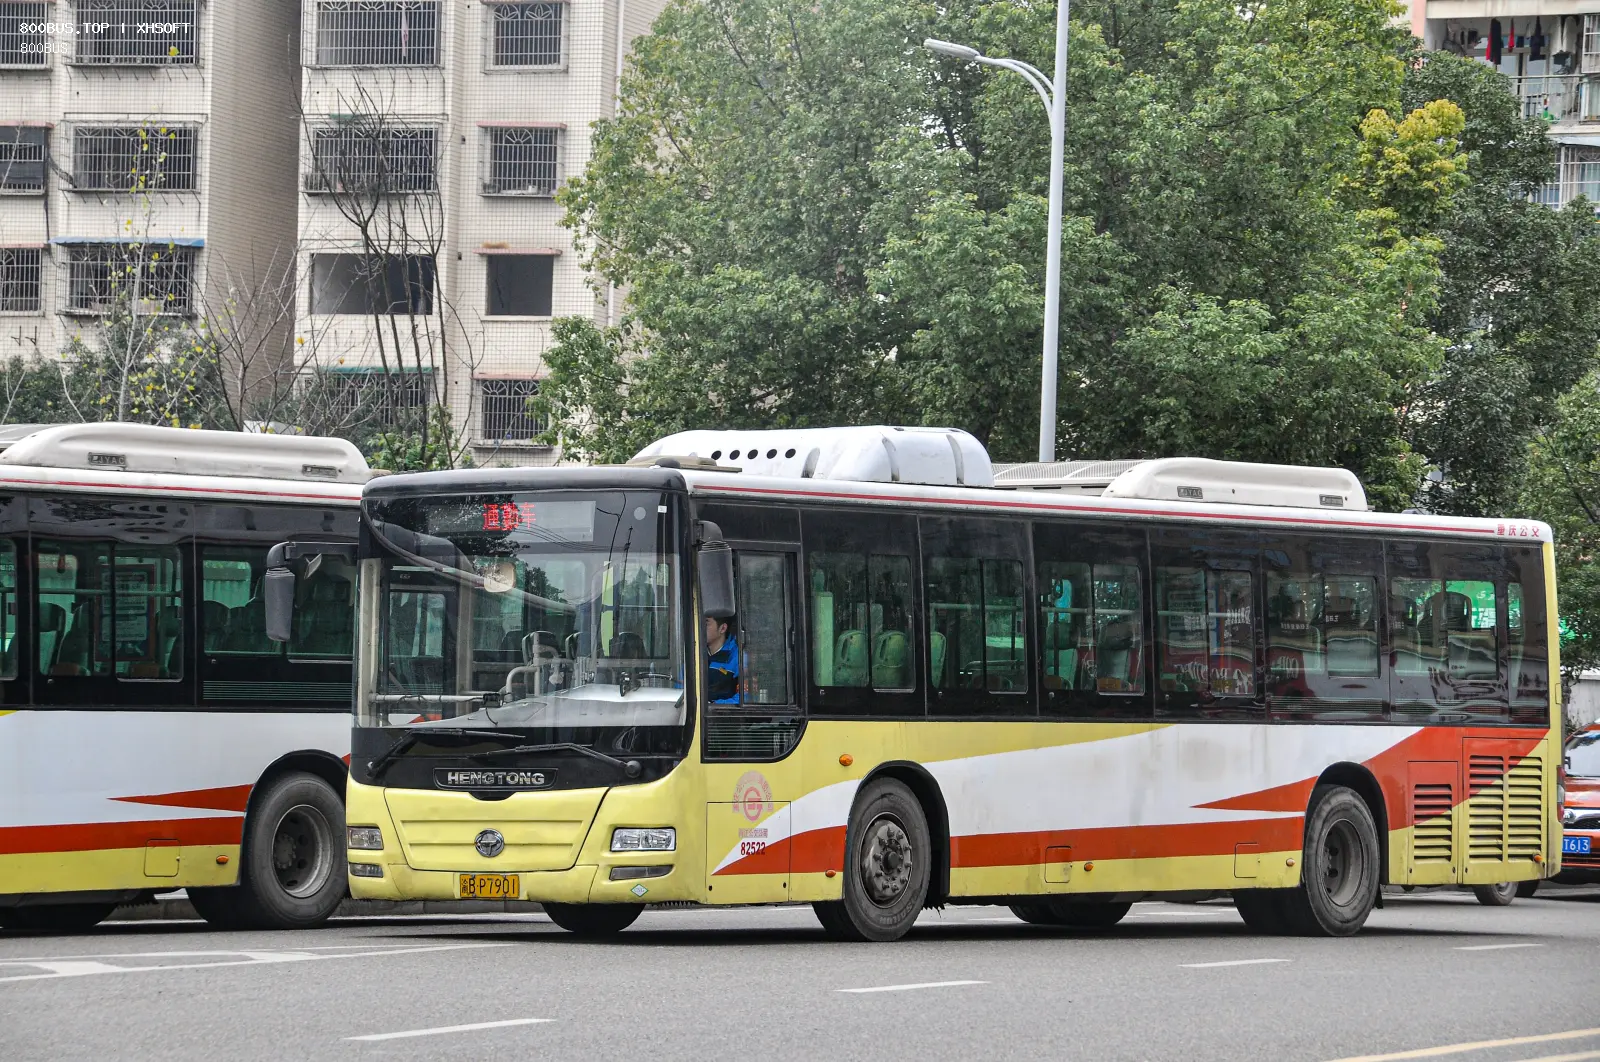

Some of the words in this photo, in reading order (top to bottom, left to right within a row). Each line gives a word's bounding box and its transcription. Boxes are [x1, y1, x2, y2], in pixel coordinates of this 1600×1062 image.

[482, 502, 537, 531] 通勤车
[447, 771, 545, 785] HENGTONG
[740, 842, 766, 856] 82522
